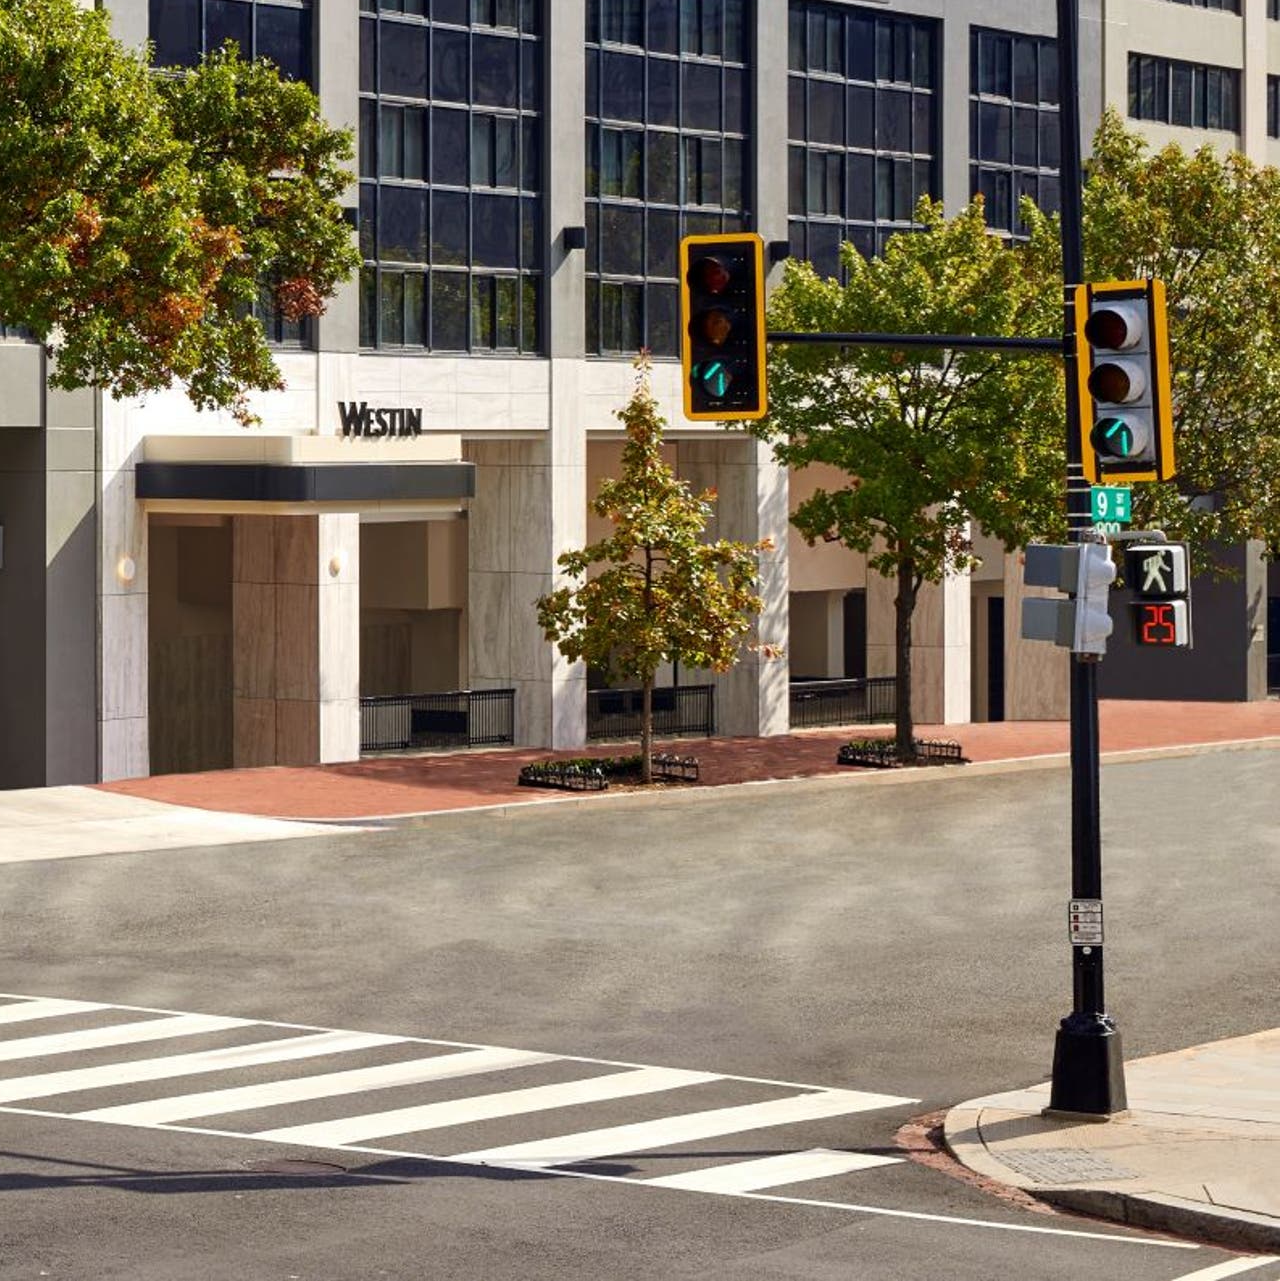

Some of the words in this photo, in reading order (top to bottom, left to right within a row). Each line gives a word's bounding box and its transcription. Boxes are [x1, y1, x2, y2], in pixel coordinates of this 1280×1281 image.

[337, 401, 423, 437] WESTIN
[1097, 491, 1108, 518] 9
[1144, 606, 1175, 642] 25
